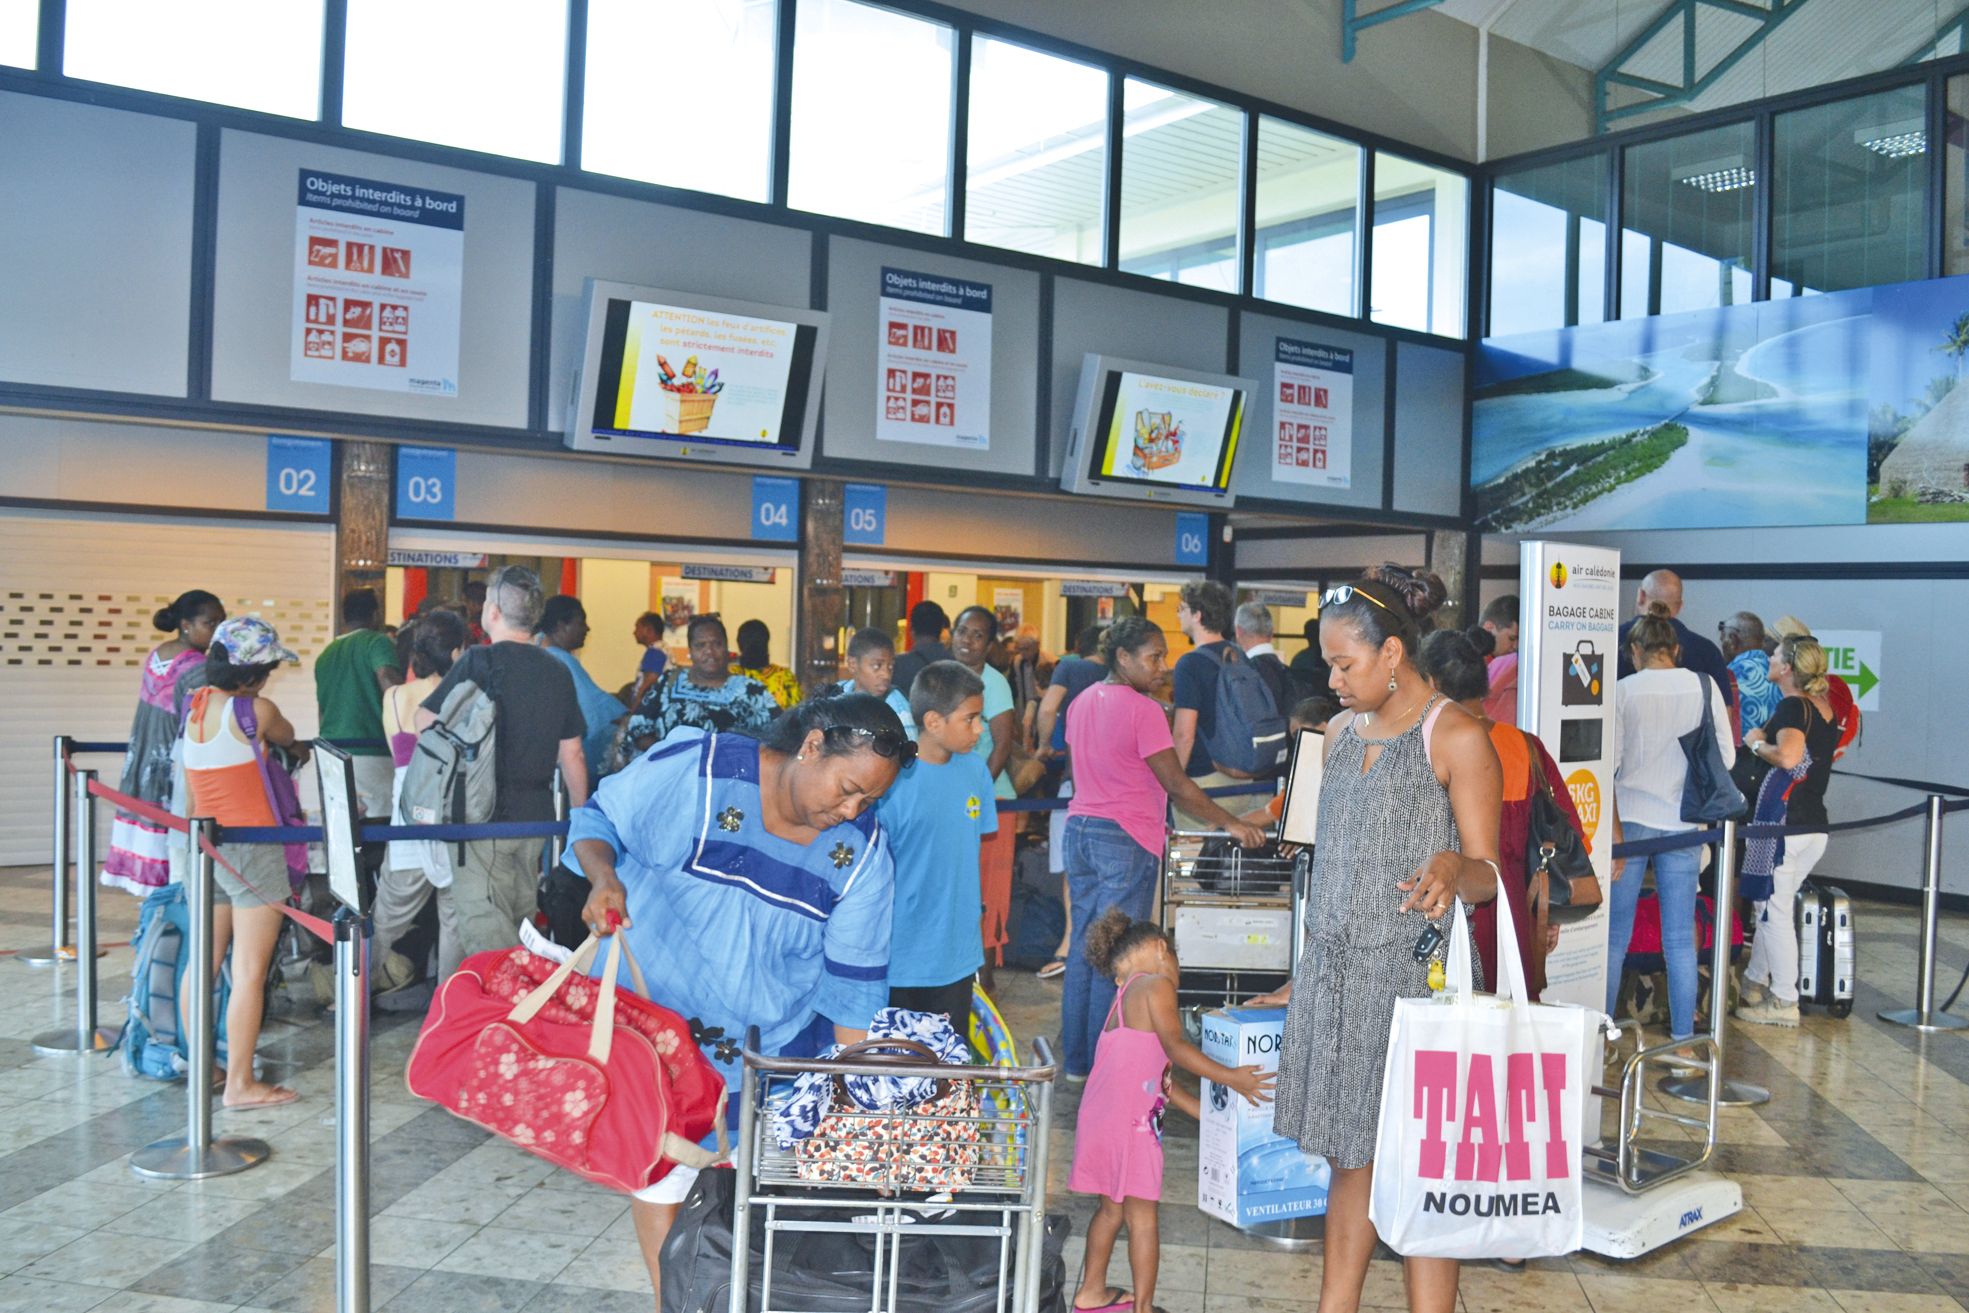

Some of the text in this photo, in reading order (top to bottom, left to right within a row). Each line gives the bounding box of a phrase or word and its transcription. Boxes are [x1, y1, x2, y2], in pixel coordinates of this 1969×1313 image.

[306, 177, 457, 213] Objets interdits à bord
[305, 194, 420, 218] Items prohibited on board
[886, 273, 917, 288] Objets
[919, 279, 956, 294] interdits
[965, 286, 987, 299] bord
[652, 310, 705, 325] ATTENTION
[707, 318, 720, 327] les
[660, 324, 672, 334] les
[660, 338, 774, 359] sont strictement interdits
[1279, 342, 1300, 356] Objets
[279, 468, 316, 496] 02
[408, 476, 443, 503] 03
[760, 502, 788, 527] 04
[850, 508, 877, 531] 05
[1182, 533, 1202, 553] 06
[390, 551, 459, 565] STINATIONS
[684, 565, 753, 580] DESTINATIONS
[1572, 564, 1615, 578] air calédonie
[1063, 584, 1114, 595] DESTINATIONS
[1548, 605, 1614, 620] BAGAGE CABINE
[1548, 621, 1614, 632] CARRY ON BAGGAGE
[1413, 1050, 1569, 1182] TATI
[1246, 1200, 1312, 1217] VENTILATEUR
[1423, 1192, 1561, 1217] NOUMEA
[1679, 1206, 1703, 1229] ATRAX
